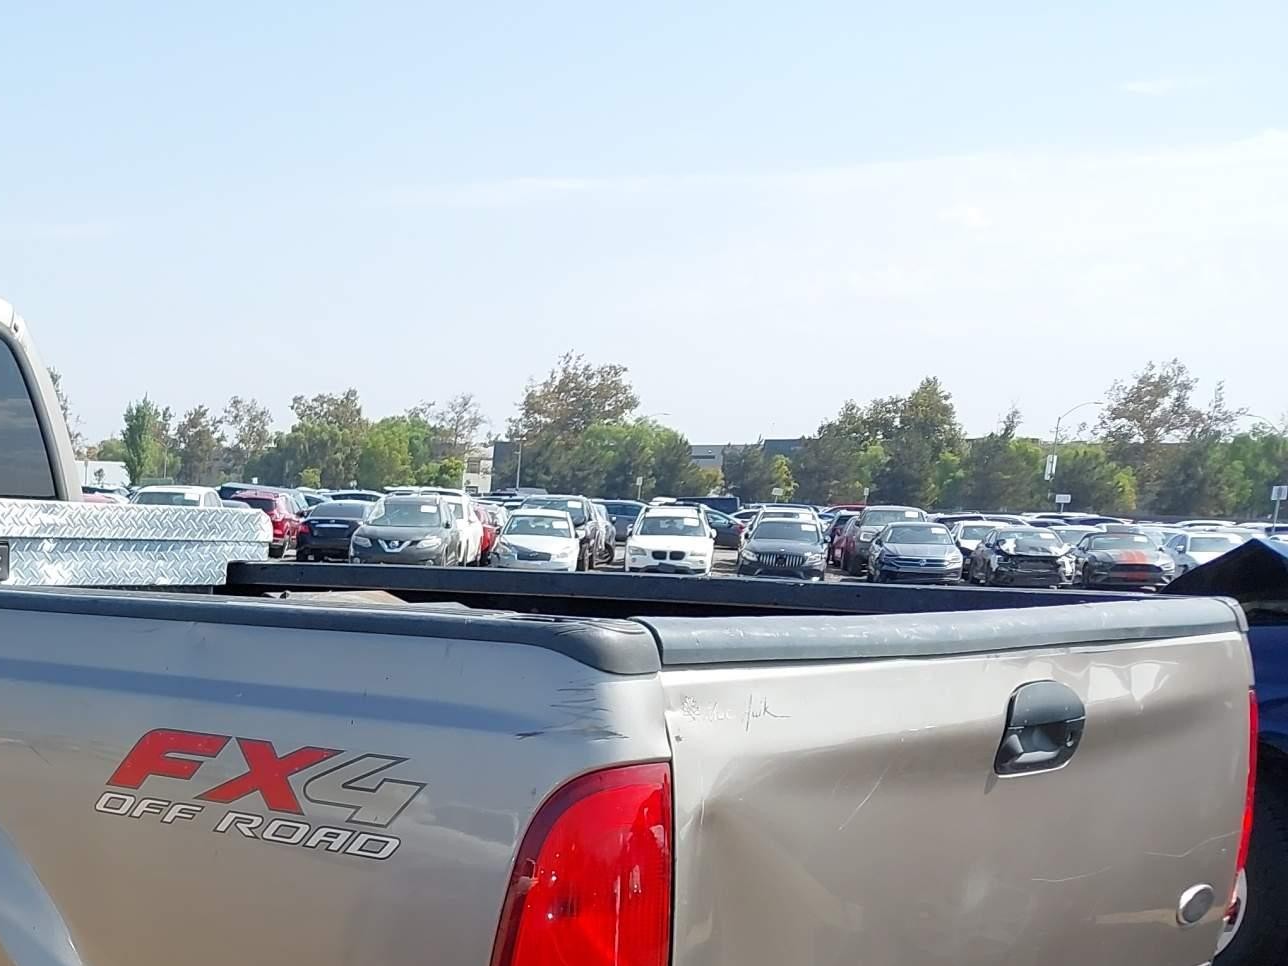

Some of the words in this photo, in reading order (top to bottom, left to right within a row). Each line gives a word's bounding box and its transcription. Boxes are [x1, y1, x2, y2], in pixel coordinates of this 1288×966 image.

[106, 728, 428, 828] FX4
[95, 790, 205, 824] OFF
[213, 810, 402, 860] ROAD
